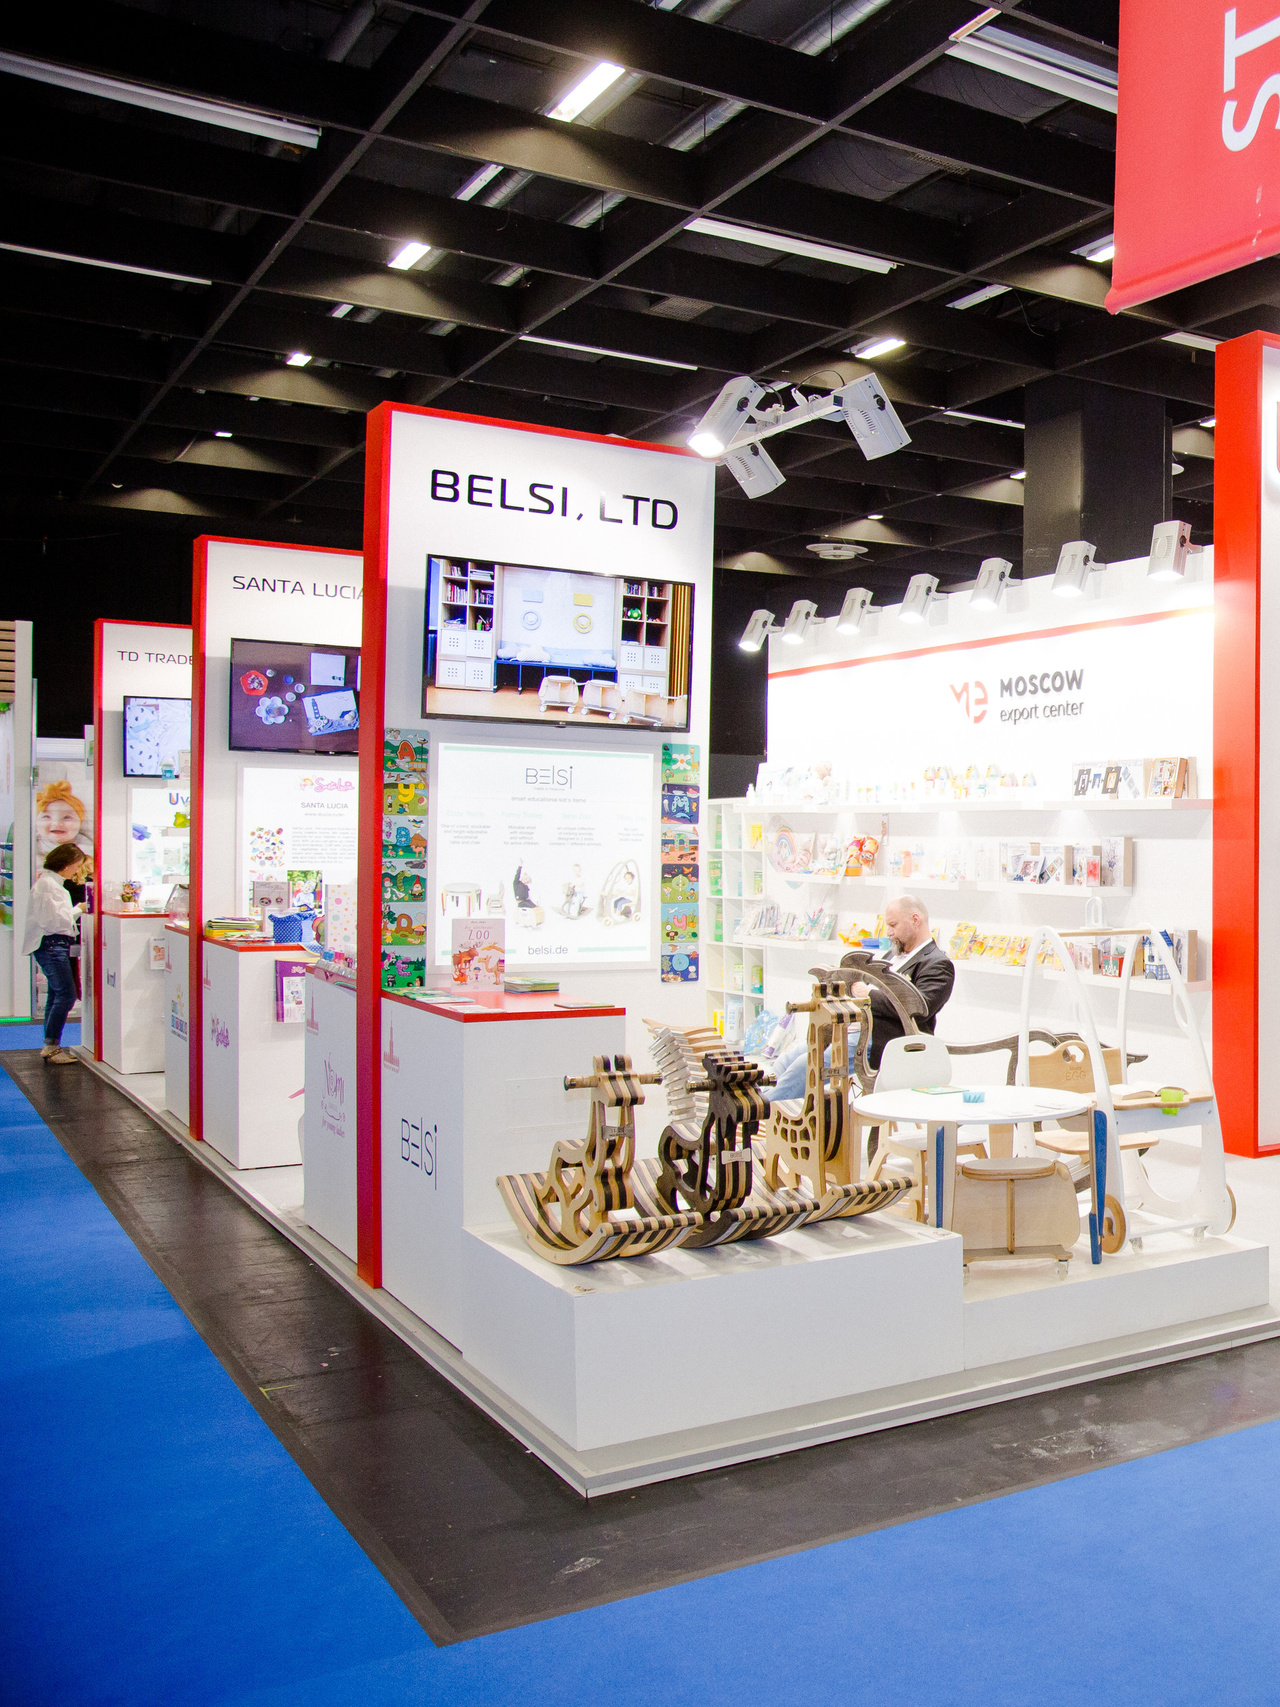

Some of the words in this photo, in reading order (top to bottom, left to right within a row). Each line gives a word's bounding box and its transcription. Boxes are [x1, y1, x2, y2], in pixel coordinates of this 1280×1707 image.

[430, 468, 584, 522] BELSI,
[599, 490, 680, 531] LTD
[232, 575, 305, 596] SANTA
[117, 650, 139, 662] TD
[1000, 668, 1084, 698] MOSCOW
[1000, 703, 1039, 725] export
[1043, 700, 1084, 719] center
[468, 929, 490, 941] ZOO
[528, 945, 569, 955] belsi.de
